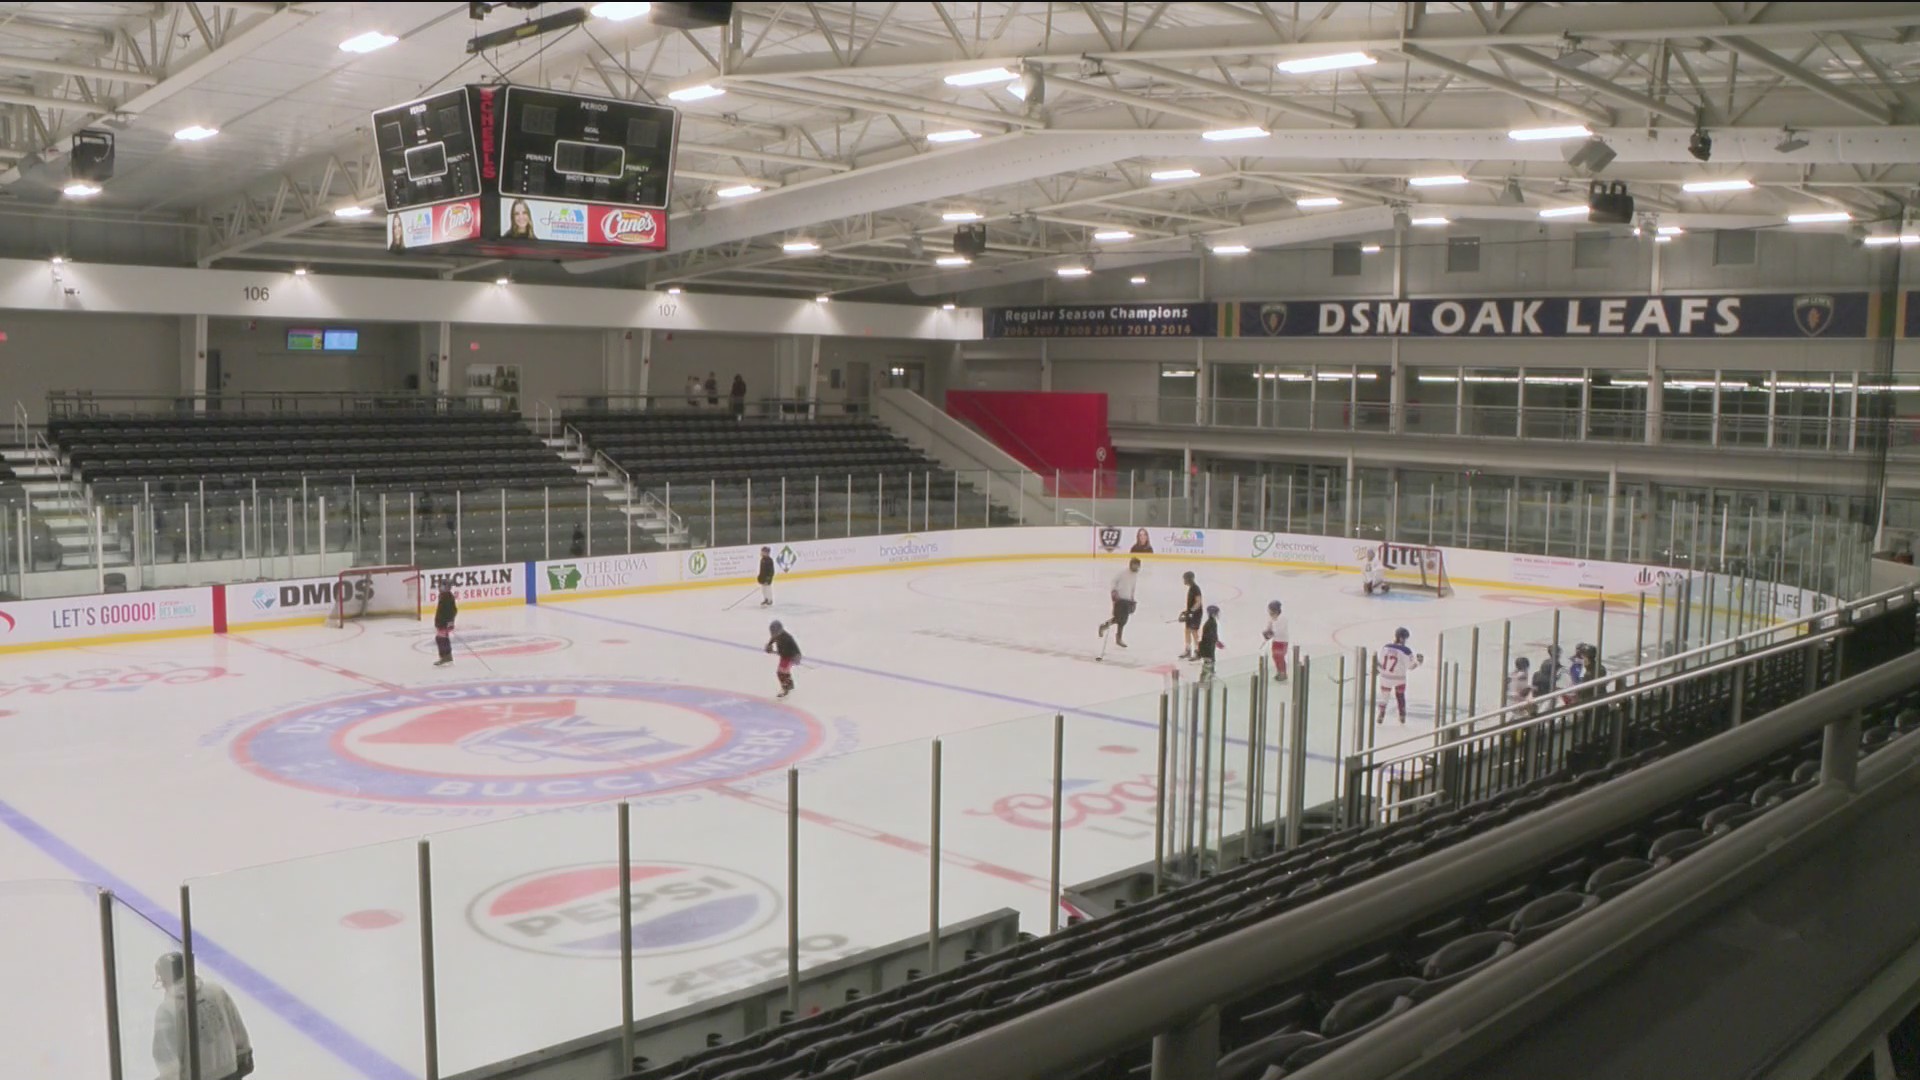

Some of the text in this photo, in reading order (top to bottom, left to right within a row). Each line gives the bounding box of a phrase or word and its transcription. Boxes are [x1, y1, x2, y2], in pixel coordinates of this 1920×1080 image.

[580, 101, 608, 112] PERIOD
[525, 153, 552, 163] PENALTY
[625, 164, 650, 173] PENALTY
[604, 209, 655, 241] Cane's
[243, 286, 270, 302] 106
[658, 303, 677, 317] 107
[1005, 306, 1189, 324] Regular Season Champions
[1318, 298, 1741, 335] DSM OAK LEAFS
[1095, 324, 1122, 336] 2011
[1127, 324, 1156, 335] 2013
[1161, 324, 1192, 335] 2014
[879, 540, 938, 557] broadlawns
[1275, 541, 1320, 553] electronic
[1273, 550, 1326, 562] engineering
[584, 558, 648, 575] THE IOWA
[584, 572, 632, 588] CLINIC
[279, 578, 375, 607] DMOS
[464, 586, 512, 599] SERVICES
[53, 602, 156, 629] LET'S GOOOO!
[1382, 655, 1398, 672] 17
[276, 706, 368, 733] DES
[371, 683, 616, 707] MOINES
[428, 727, 795, 796] BUCCANEERS
[504, 875, 739, 938] PEPSI
[648, 933, 850, 997] ZERO
